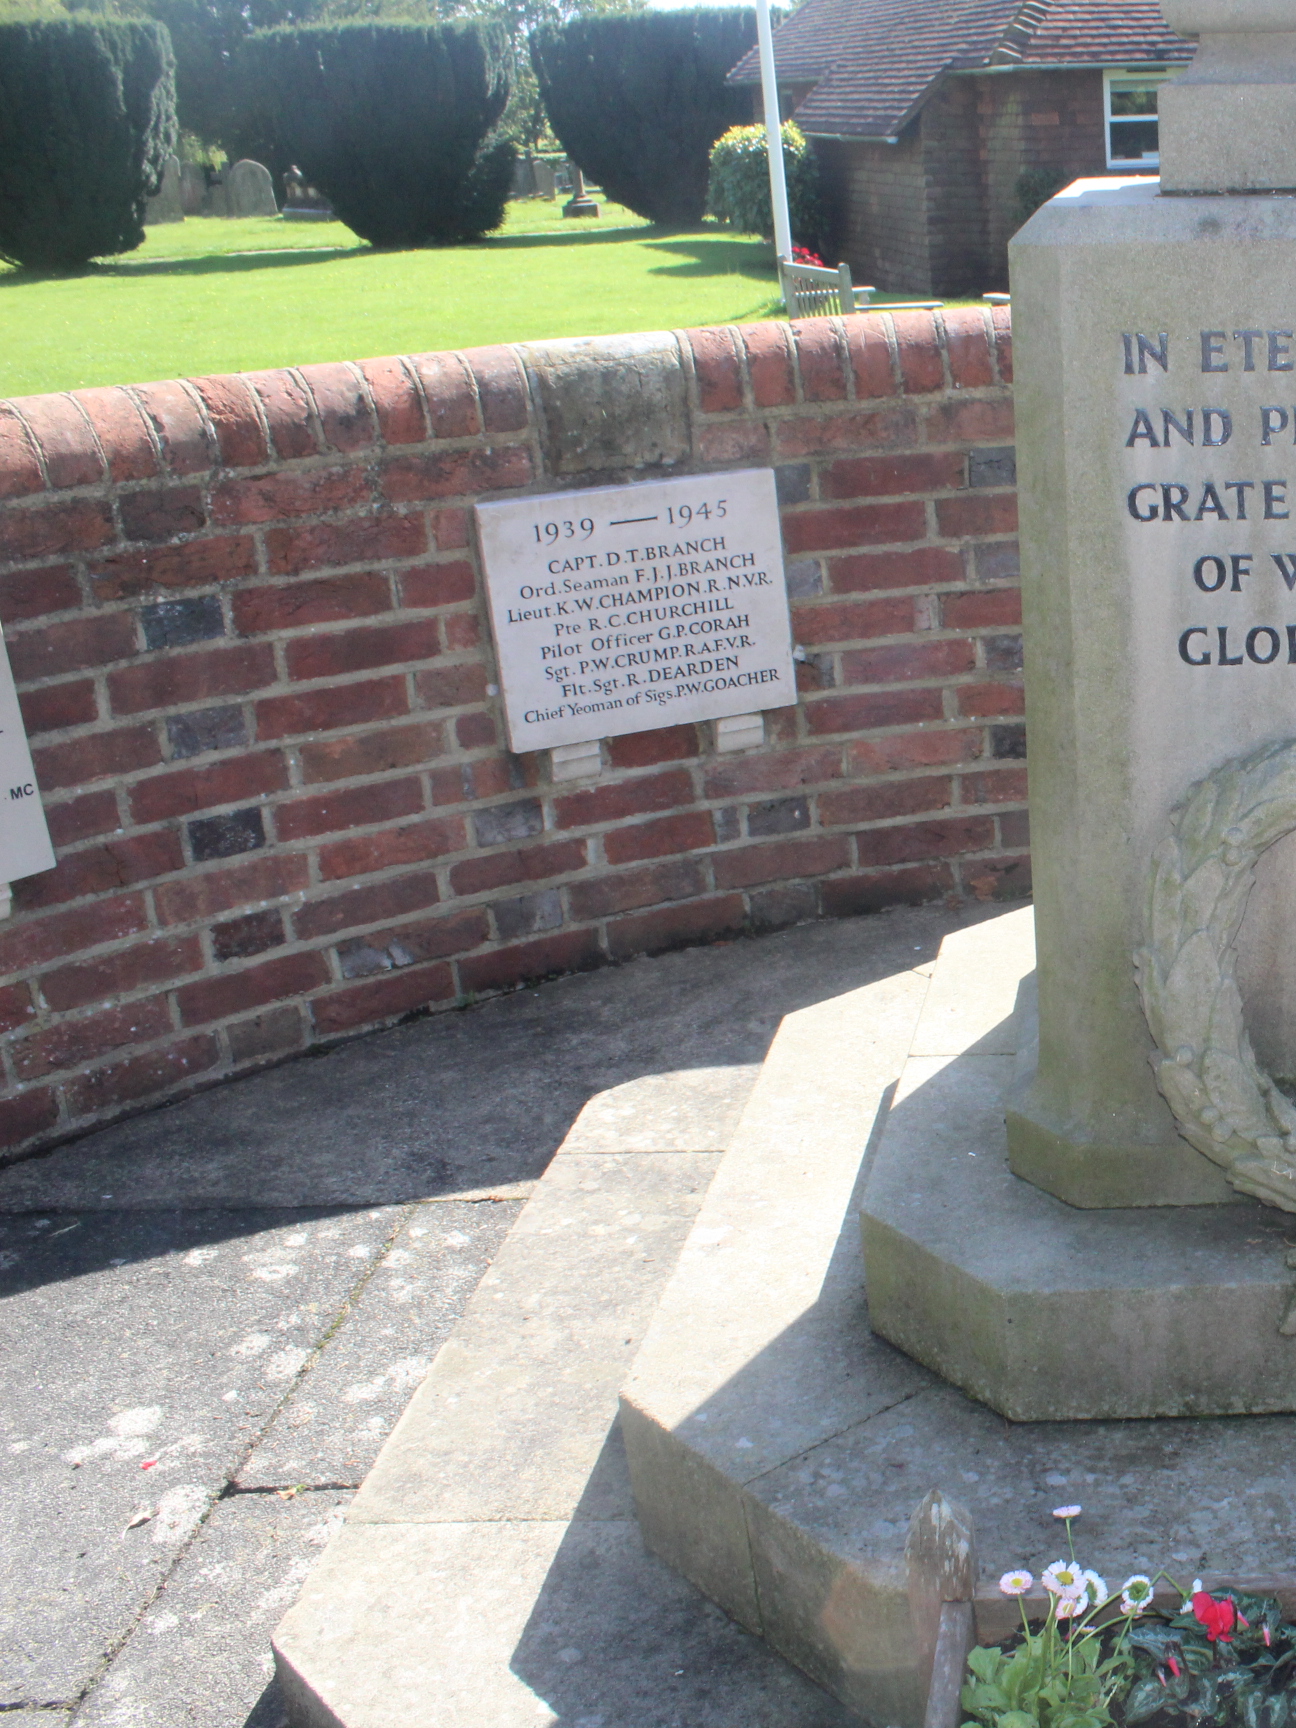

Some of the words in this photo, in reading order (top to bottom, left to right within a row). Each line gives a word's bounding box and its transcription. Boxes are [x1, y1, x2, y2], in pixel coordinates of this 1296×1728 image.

[1123, 332, 1169, 375] IN
[1126, 406, 1233, 449] AND
[533, 517, 595, 546] 1939
[667, 499, 727, 529] 1945
[1193, 554, 1253, 594] OF
[540, 643, 583, 660] Pilot
[590, 632, 654, 652] Officer
[554, 623, 582, 637] Pte
[523, 704, 566, 724] Chief
[566, 699, 624, 716] Yeoman
[625, 691, 642, 706] of
